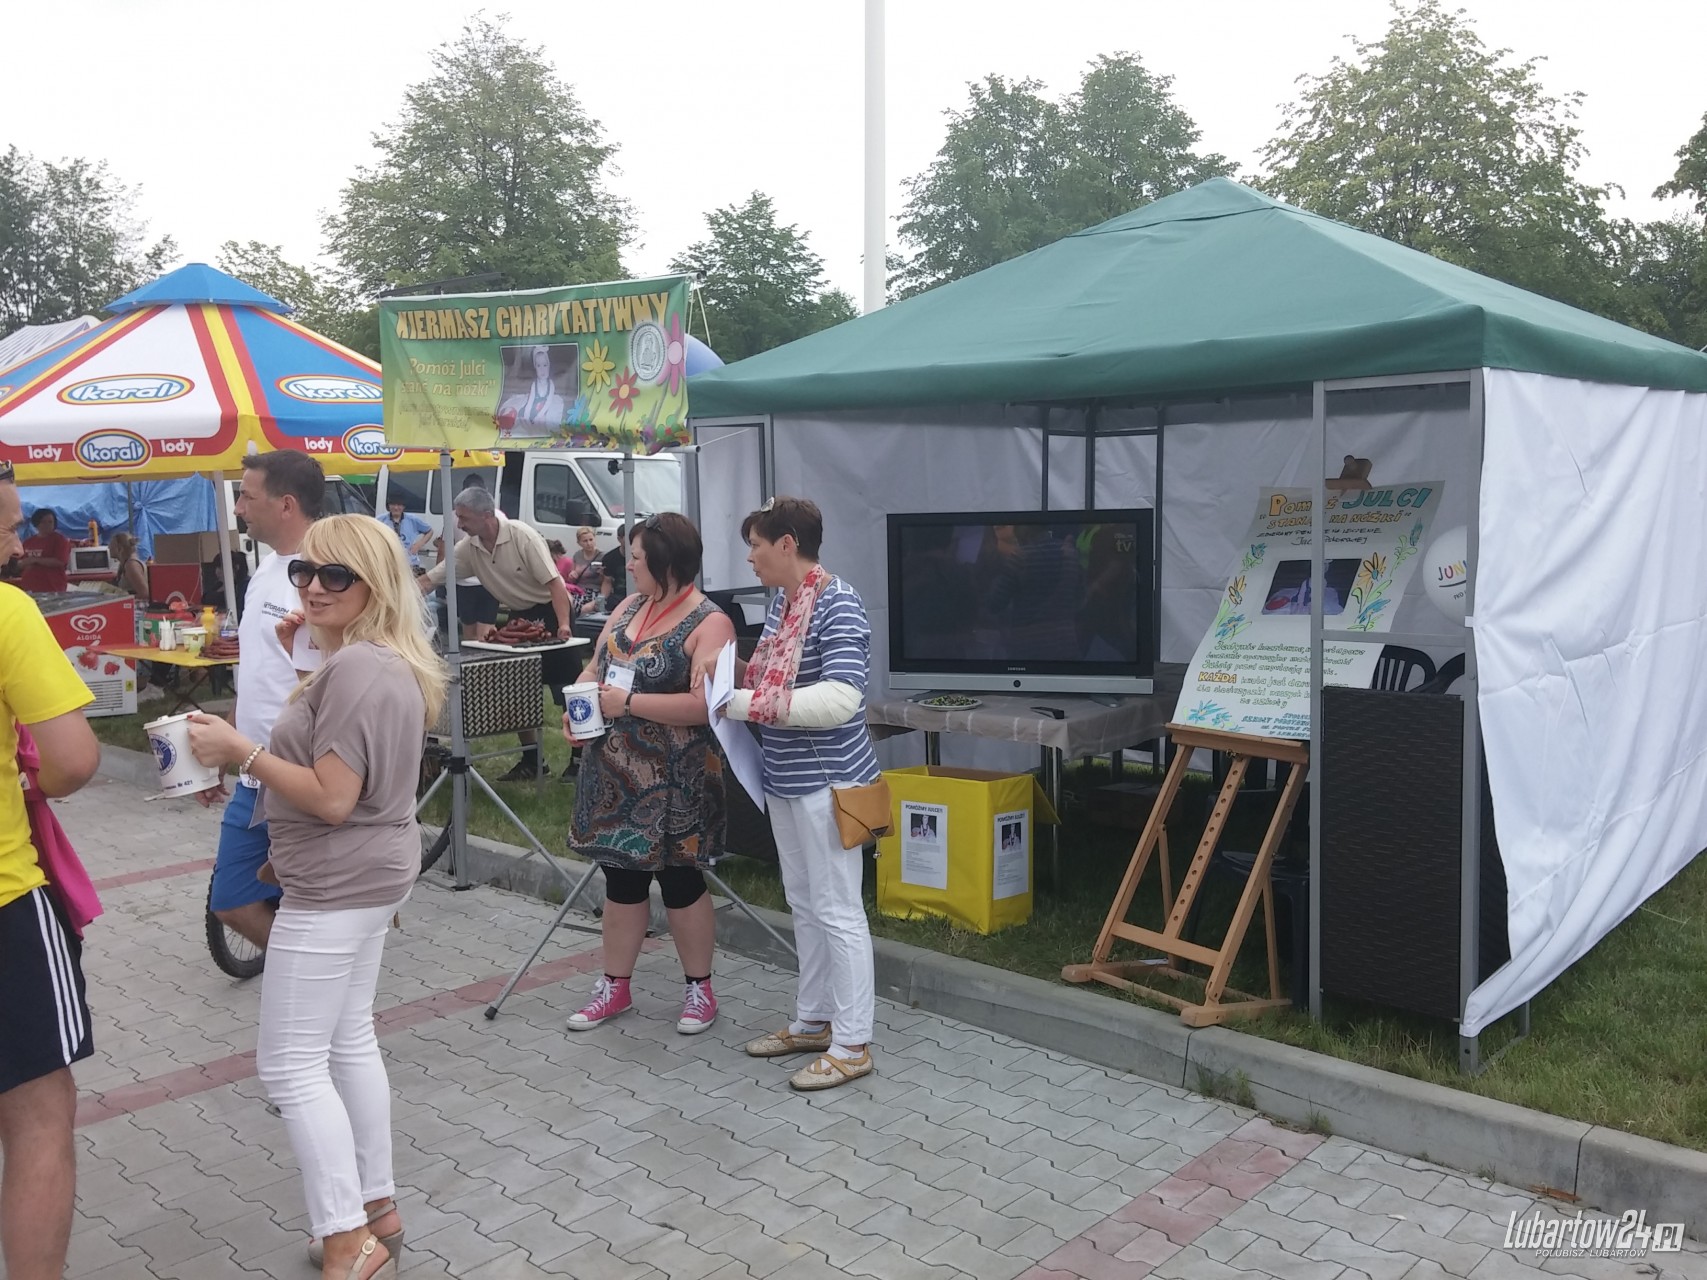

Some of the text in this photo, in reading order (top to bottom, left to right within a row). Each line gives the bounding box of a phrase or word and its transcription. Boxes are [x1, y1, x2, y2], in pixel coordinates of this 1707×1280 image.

[409, 358, 486, 380] Pomóż Julci
[80, 382, 174, 401] koral
[293, 383, 381, 400] koral
[432, 382, 452, 396] na
[28, 439, 195, 464] lody koral lody
[304, 437, 333, 453] lody
[1269, 487, 1433, 517] Pomż JULCI
[1328, 514, 1347, 524] NA
[1198, 670, 1238, 684] KAŻDA
